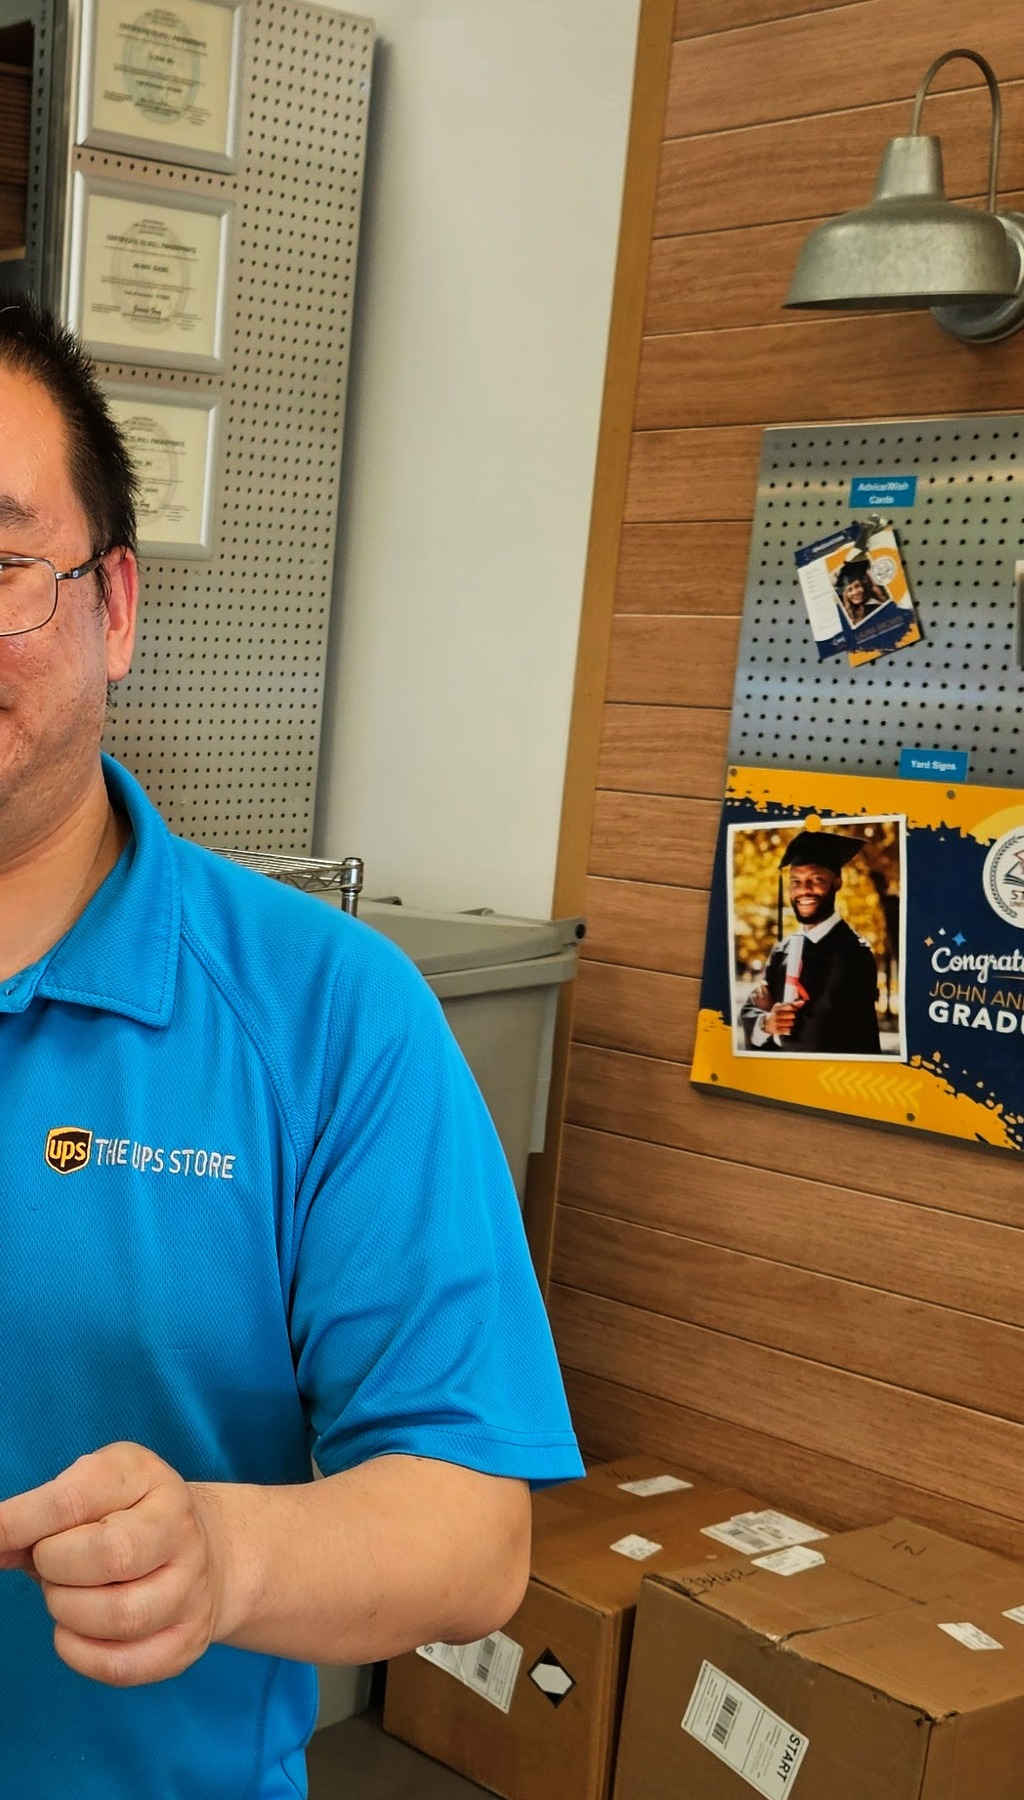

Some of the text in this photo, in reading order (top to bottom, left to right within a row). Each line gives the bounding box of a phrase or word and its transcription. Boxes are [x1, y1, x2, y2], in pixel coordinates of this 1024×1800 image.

[931, 760, 957, 771] Signs
[931, 947, 1024, 983] Congrat
[929, 980, 1024, 1011] JOHN AN
[928, 1000, 1024, 1035] GRAD
[49, 1138, 236, 1179] ups THE UPS STORE
[776, 1733, 801, 1783] START
